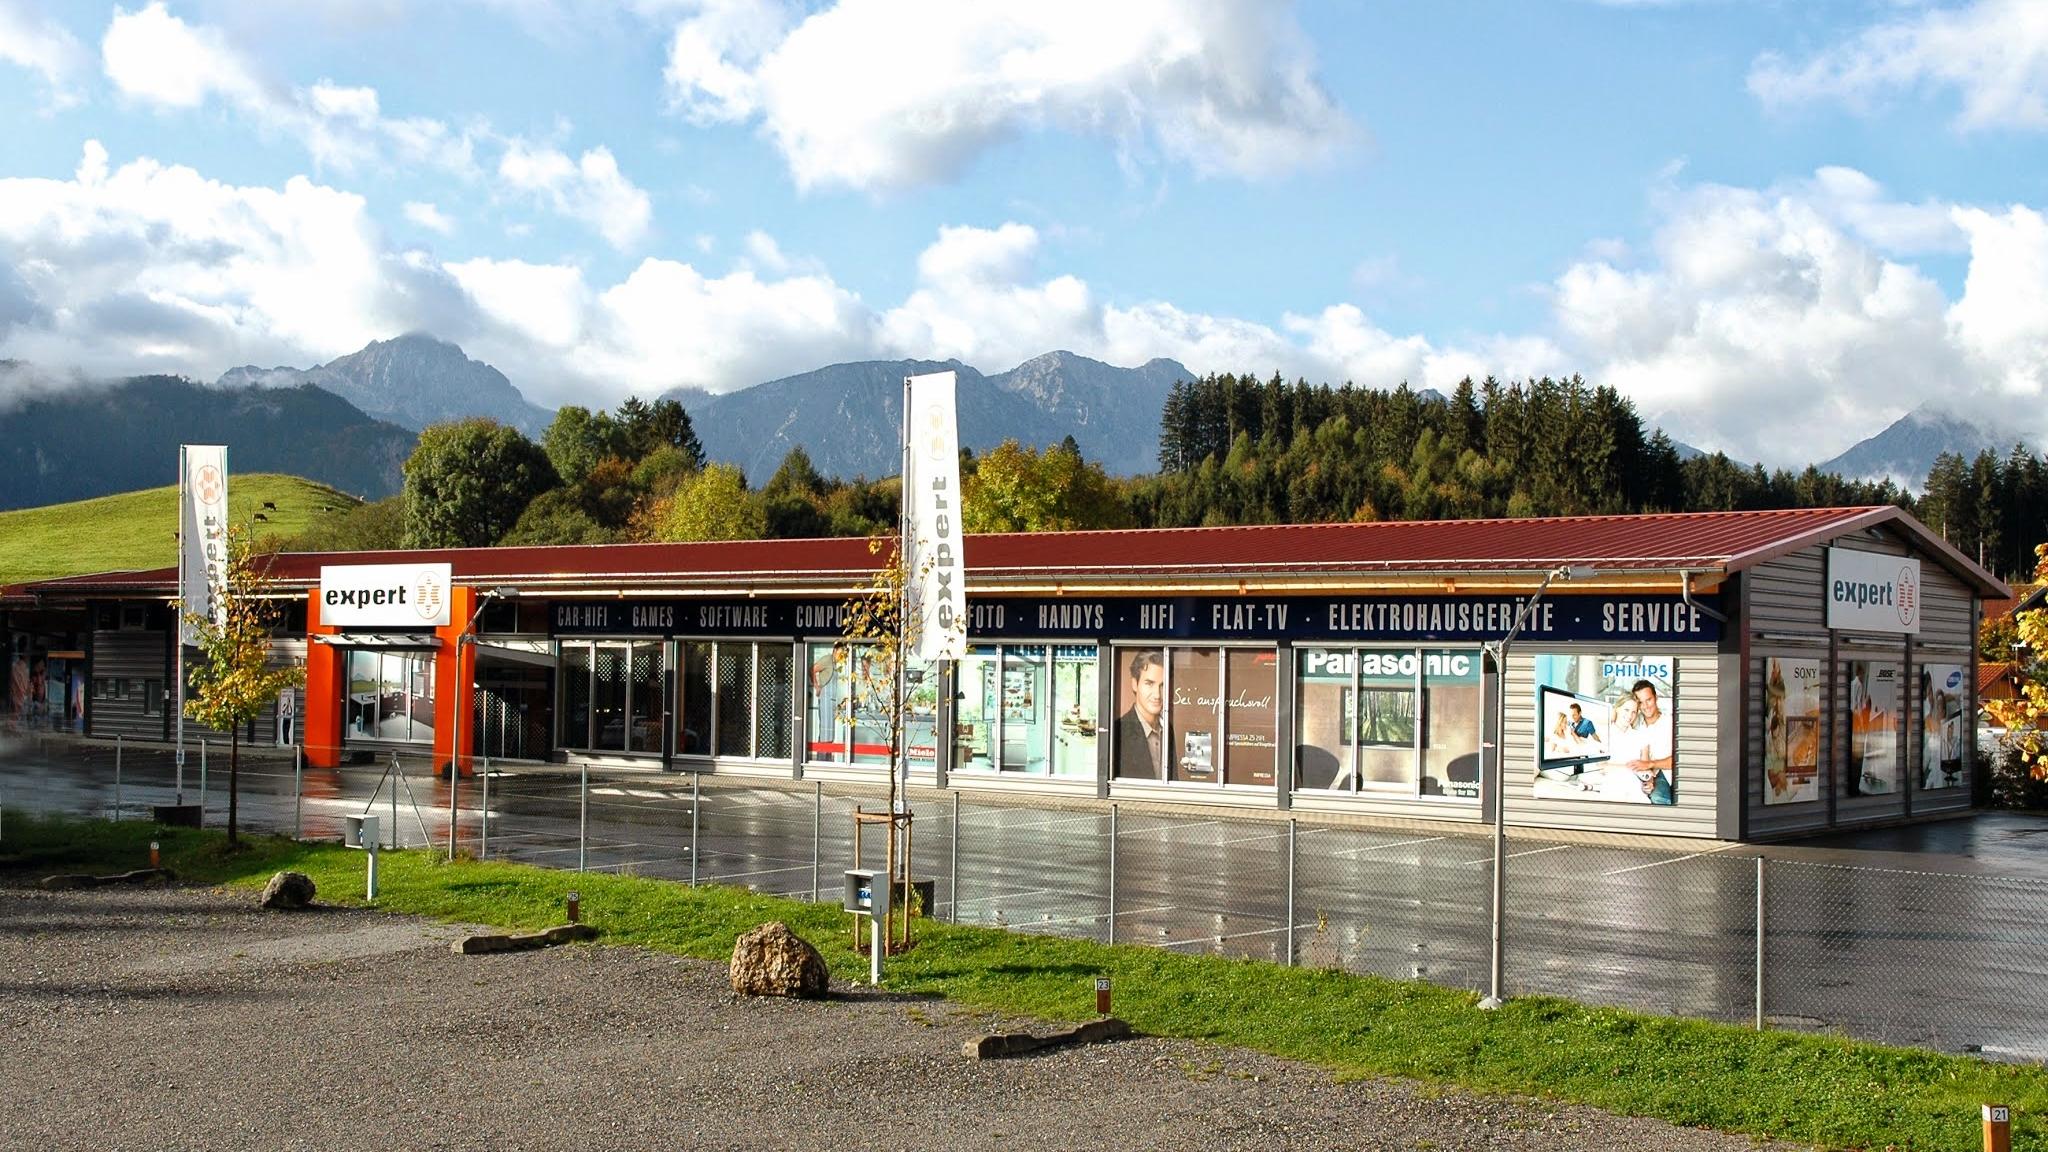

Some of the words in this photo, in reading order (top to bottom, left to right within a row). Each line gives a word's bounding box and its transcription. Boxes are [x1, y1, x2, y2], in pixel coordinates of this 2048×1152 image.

[932, 476, 954, 629] expert
[203, 516, 219, 624] expert
[325, 585, 406, 609] expert
[1833, 580, 1892, 609] expert
[557, 606, 607, 627] CAR-HIFI
[632, 606, 673, 627] GAMES
[700, 606, 767, 628] SOFTWARE
[967, 604, 1005, 629] FOTO
[1039, 604, 1104, 630] HANDYS
[1140, 604, 1174, 630] HIFI
[1212, 604, 1288, 631] FLAT-TV
[1329, 597, 1553, 632] ELEKTROHAUSGERÄTE
[1602, 602, 1701, 633] SERVICE
[1307, 648, 1470, 676] Panasonic
[1604, 664, 1668, 677] PHILIPS
[1794, 667, 1817, 679] SONY
[1099, 981, 1108, 989] 23
[1995, 1110, 2006, 1120] 21
